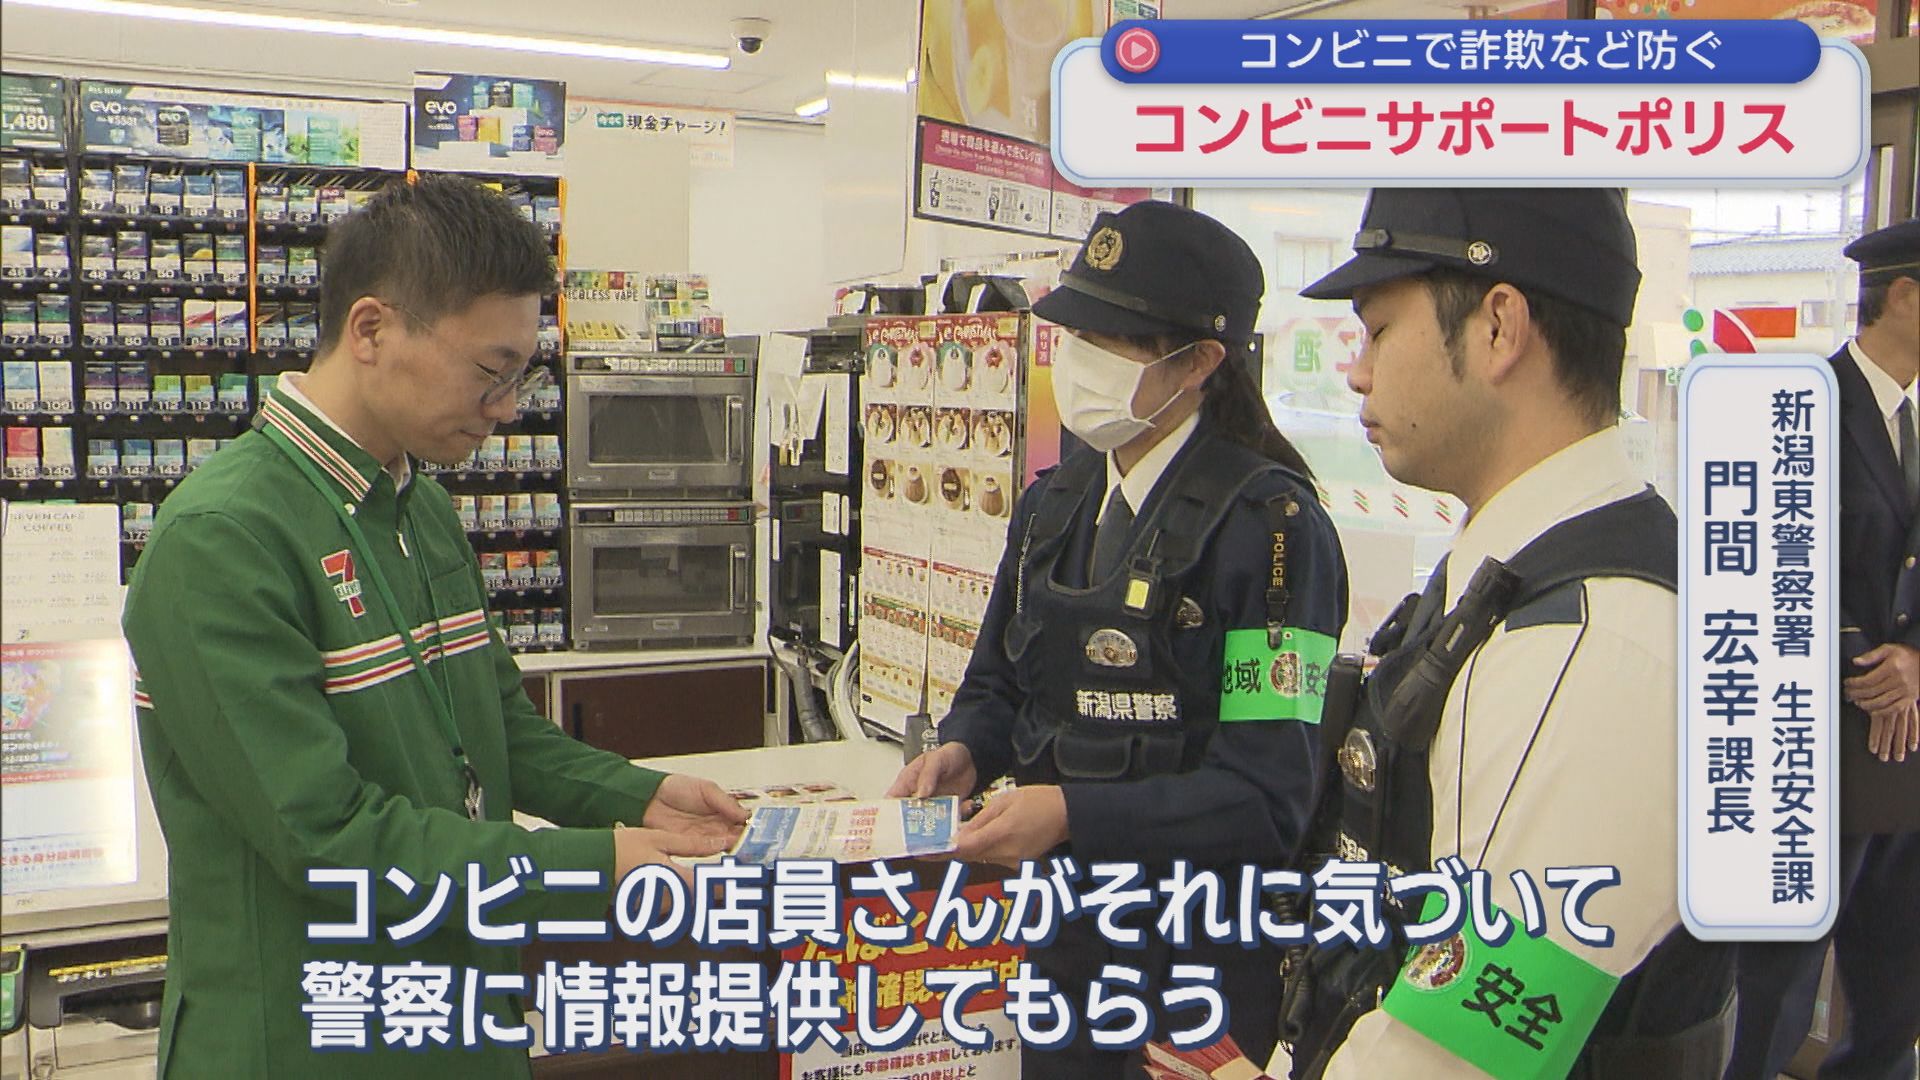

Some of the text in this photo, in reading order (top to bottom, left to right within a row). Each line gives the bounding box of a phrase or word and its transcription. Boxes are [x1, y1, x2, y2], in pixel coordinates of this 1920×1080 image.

[90, 101, 122, 114] evo
[425, 100, 457, 115] evo
[1272, 532, 1285, 587] POLICE
[1076, 689, 1178, 721] 新潟県警察
[1461, 962, 1564, 1051] 安全
